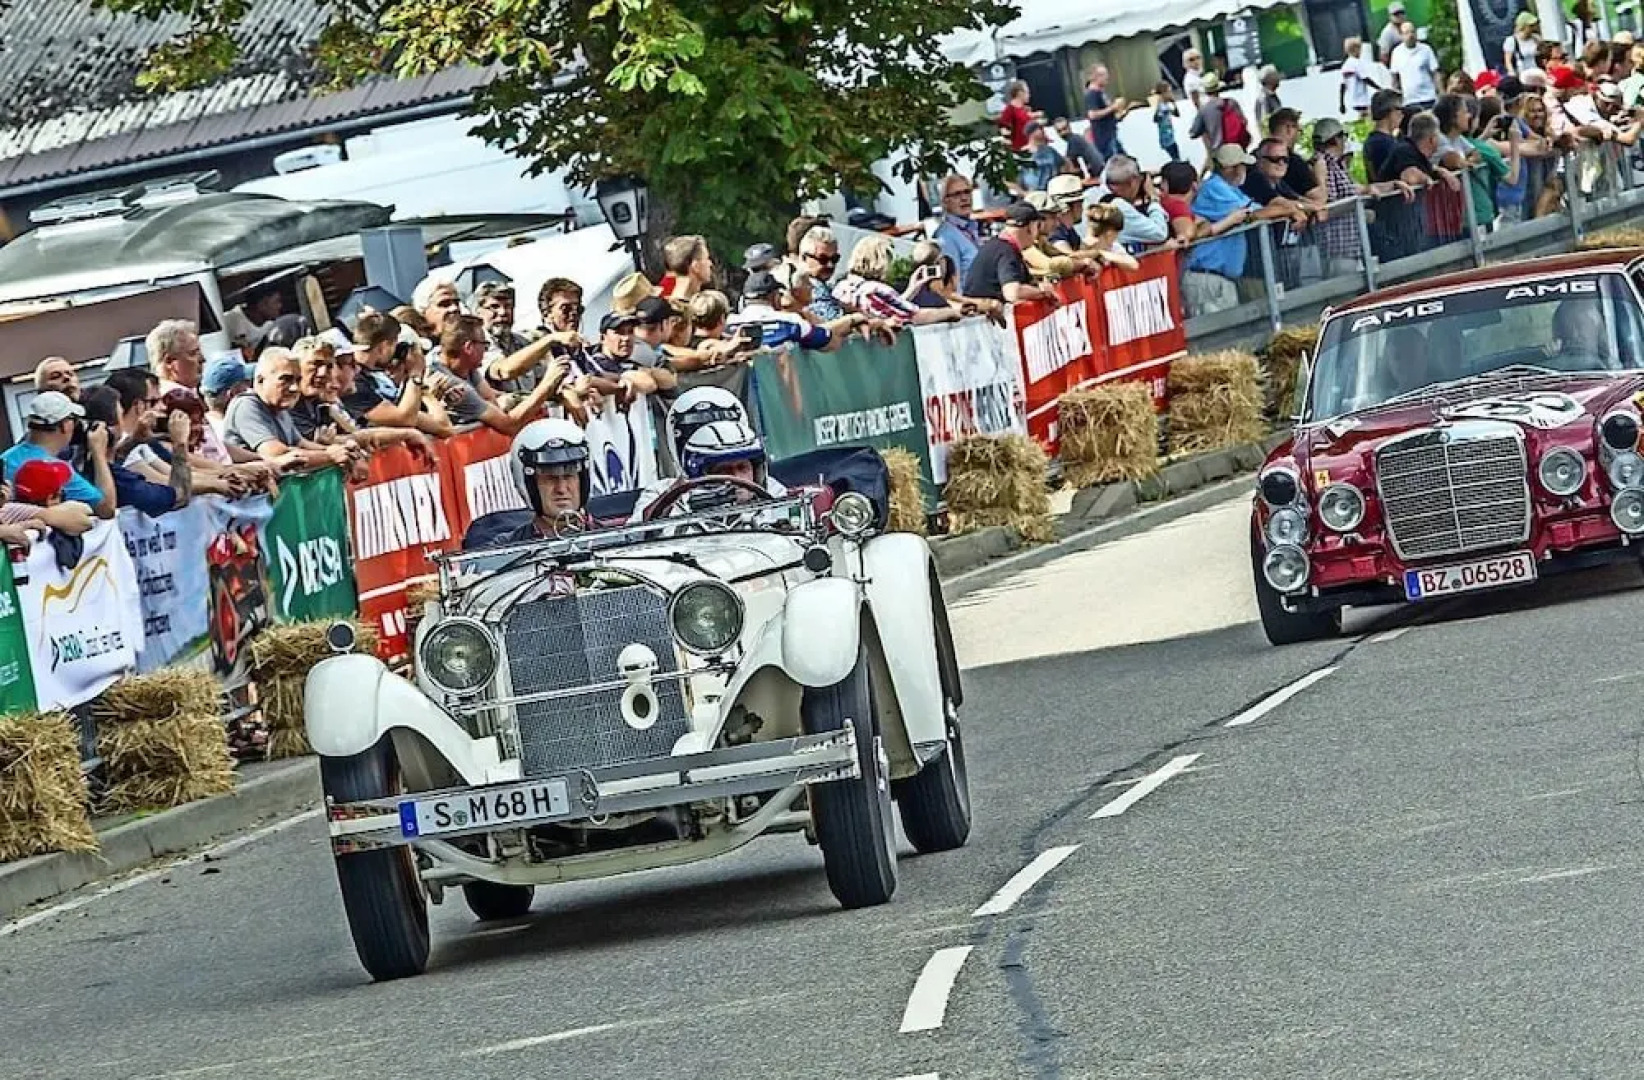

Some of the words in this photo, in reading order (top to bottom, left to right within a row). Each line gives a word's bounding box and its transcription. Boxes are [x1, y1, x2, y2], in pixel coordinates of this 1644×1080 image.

[1504, 280, 1598, 300] AMG
[1351, 300, 1445, 333] AMG
[1421, 571, 1450, 593] BZ
[1461, 558, 1526, 586] 06528
[433, 801, 451, 827] S
